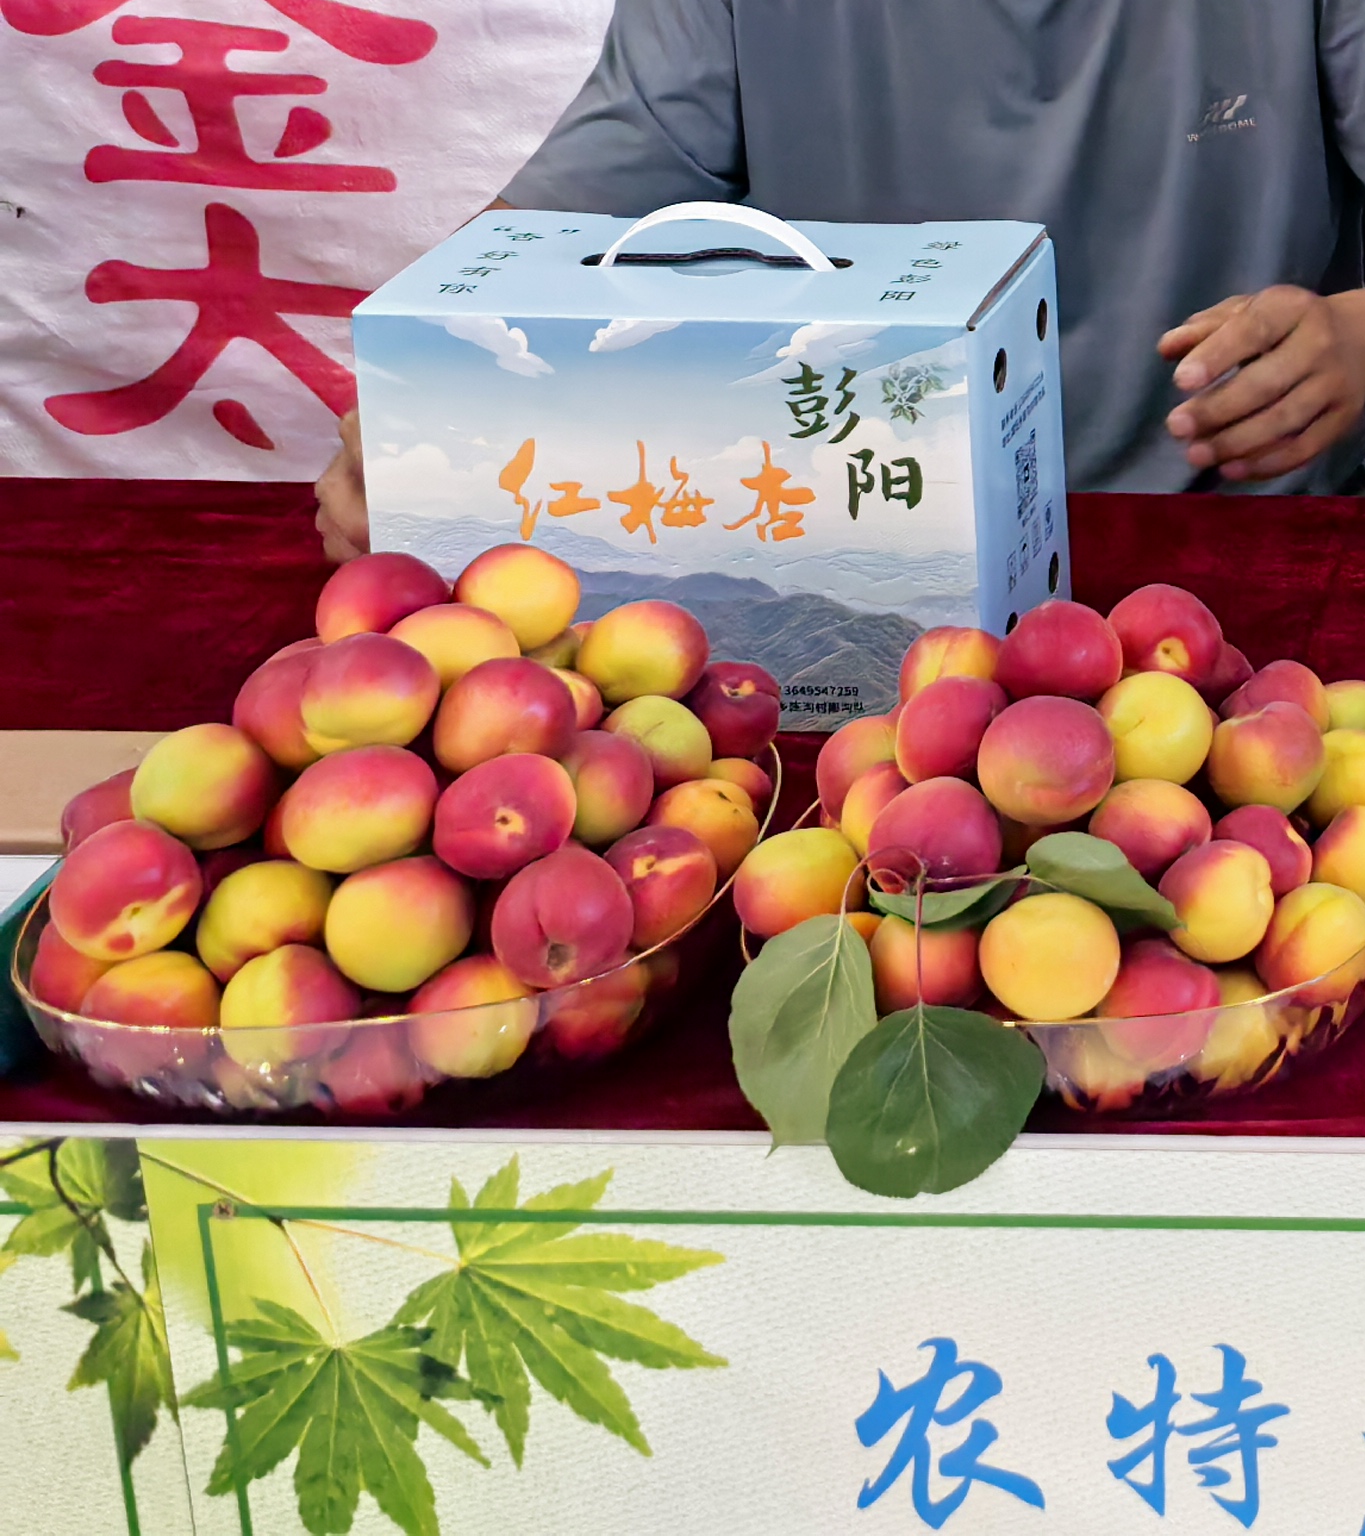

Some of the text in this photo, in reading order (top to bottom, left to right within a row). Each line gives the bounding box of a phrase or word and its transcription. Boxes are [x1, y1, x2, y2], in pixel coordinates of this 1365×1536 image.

[498, 437, 818, 544] 红梅杏
[781, 360, 924, 522] 彭阳
